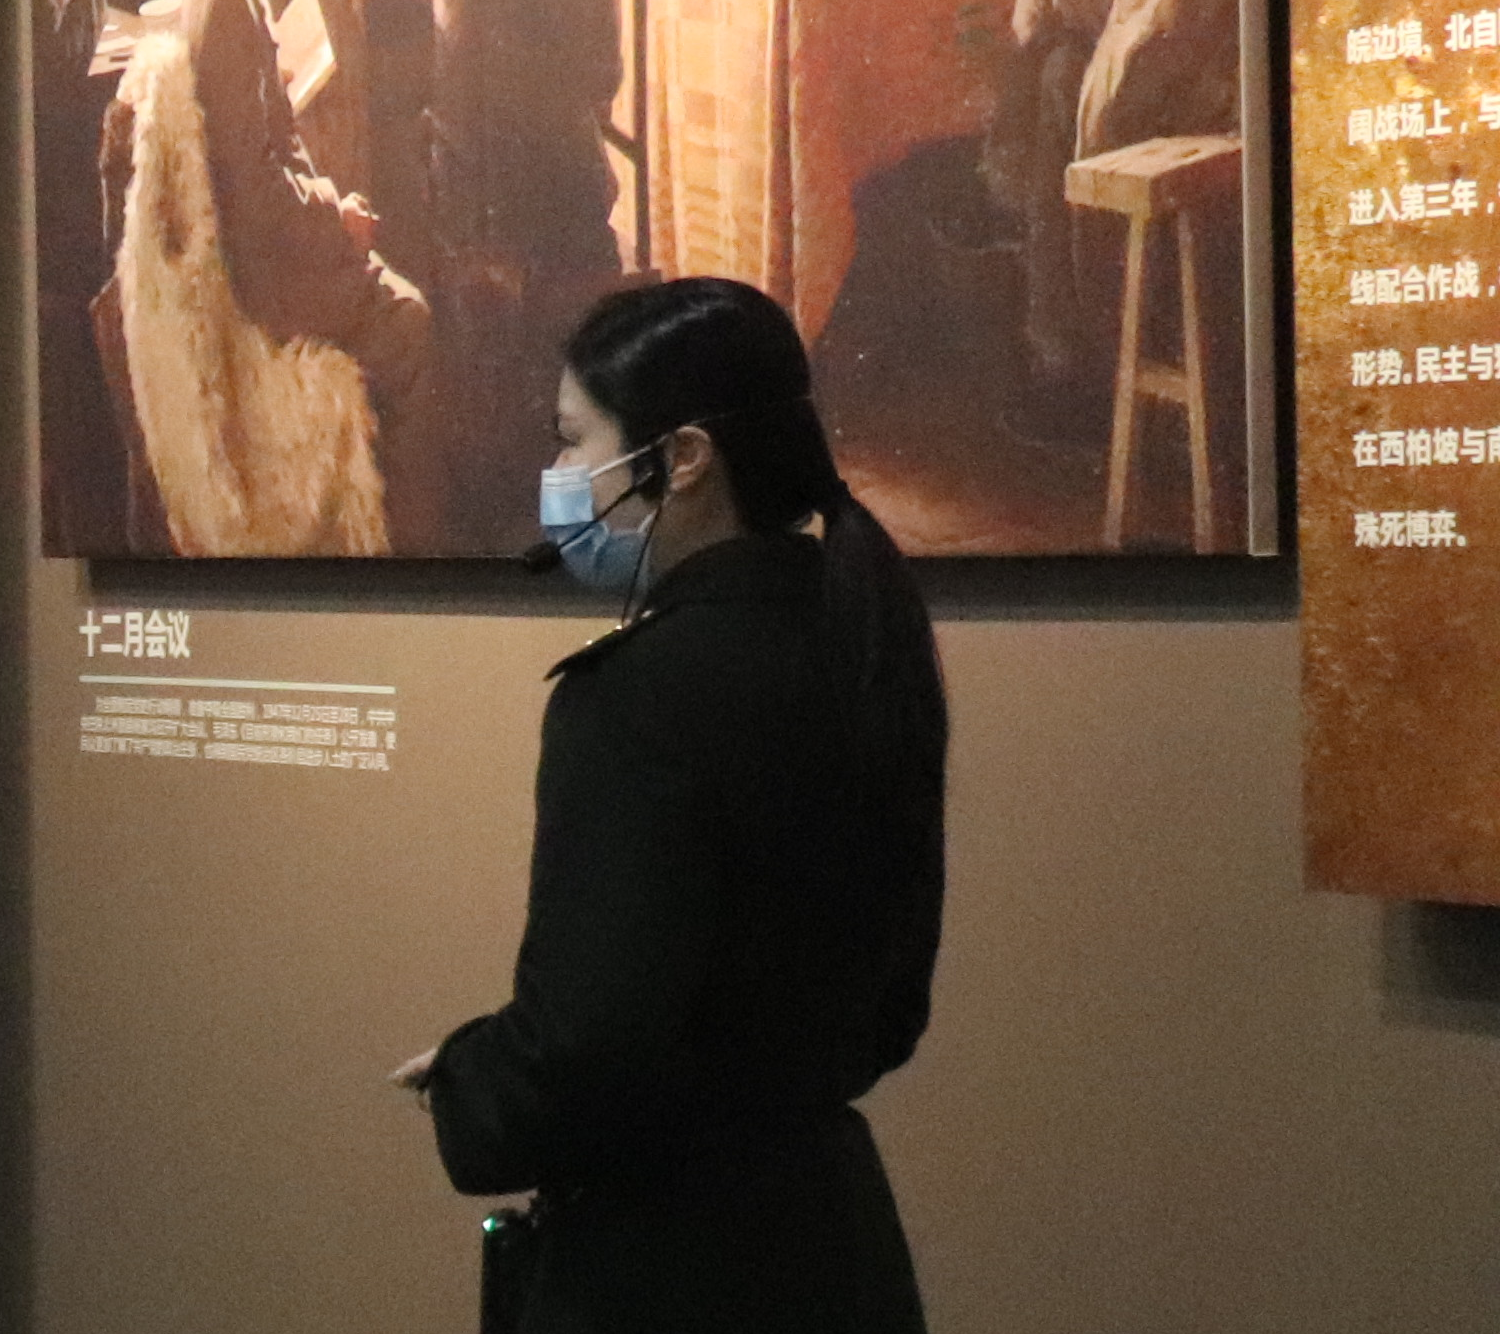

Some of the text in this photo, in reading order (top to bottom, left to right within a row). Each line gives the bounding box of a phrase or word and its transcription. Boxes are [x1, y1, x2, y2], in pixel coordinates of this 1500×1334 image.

[1346, 9, 1500, 65] 皖边境。北自
[1347, 179, 1500, 226] 进入第三年，
[1349, 261, 1500, 306] 线配合作战，
[1354, 509, 1468, 549] 殊死博弈。
[78, 609, 191, 659] 十二月会议
